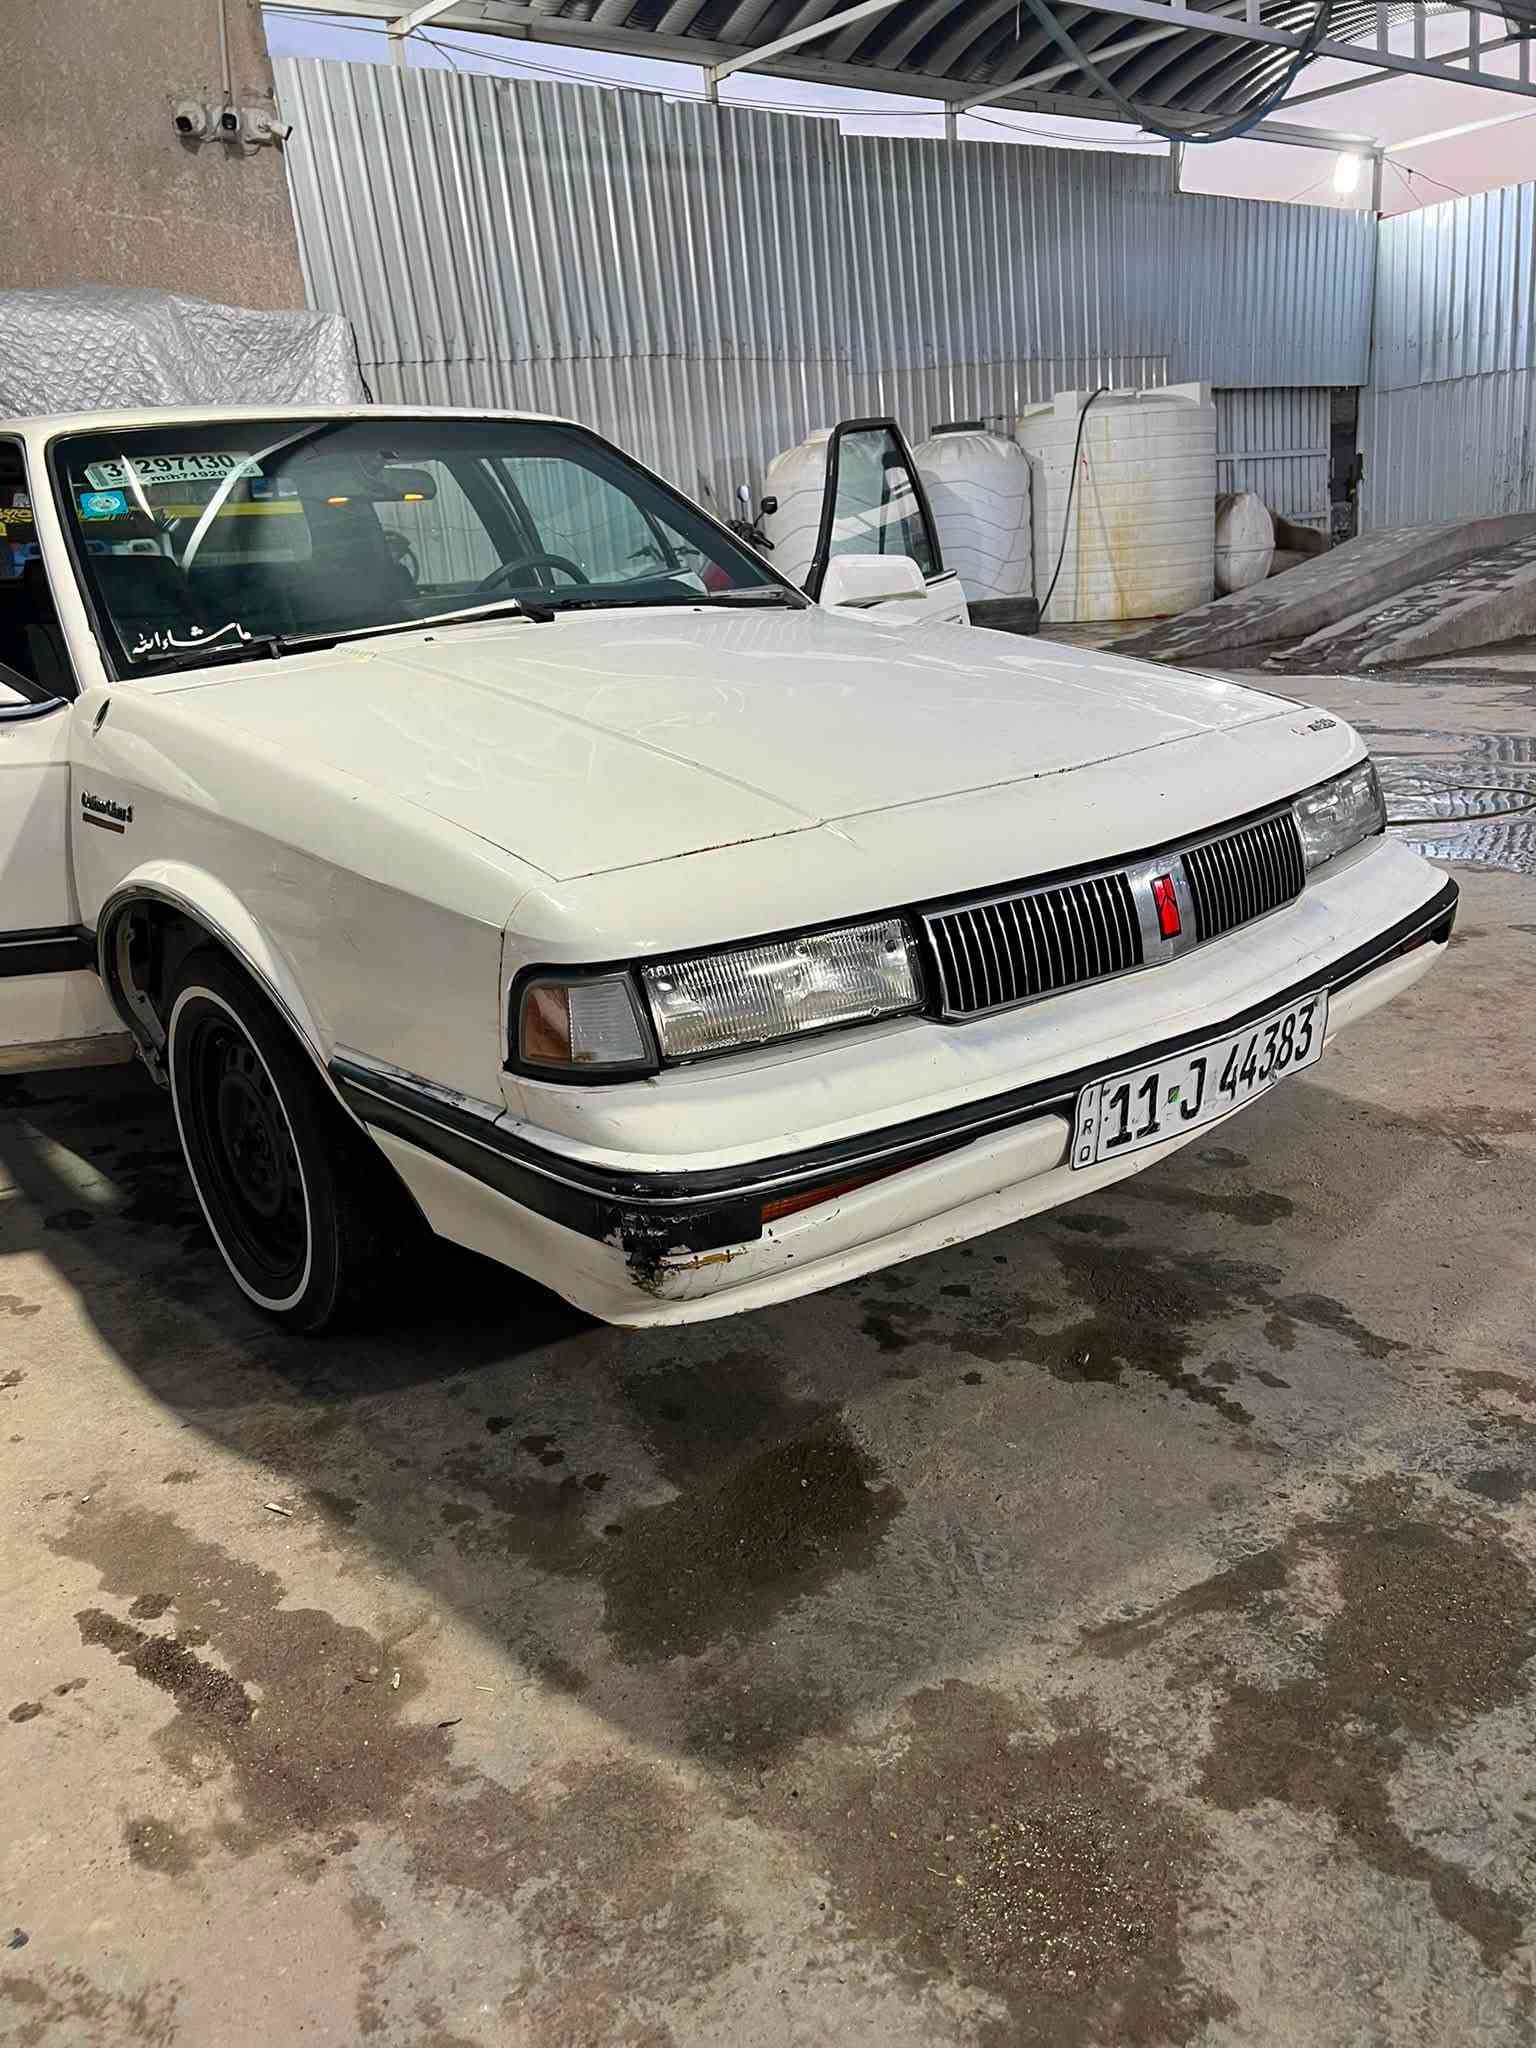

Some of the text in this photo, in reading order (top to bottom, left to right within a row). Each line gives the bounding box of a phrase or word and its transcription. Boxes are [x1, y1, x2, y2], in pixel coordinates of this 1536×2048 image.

[103, 454, 235, 478] 3297130
[1106, 1002, 1318, 1149] 11 J 44383
